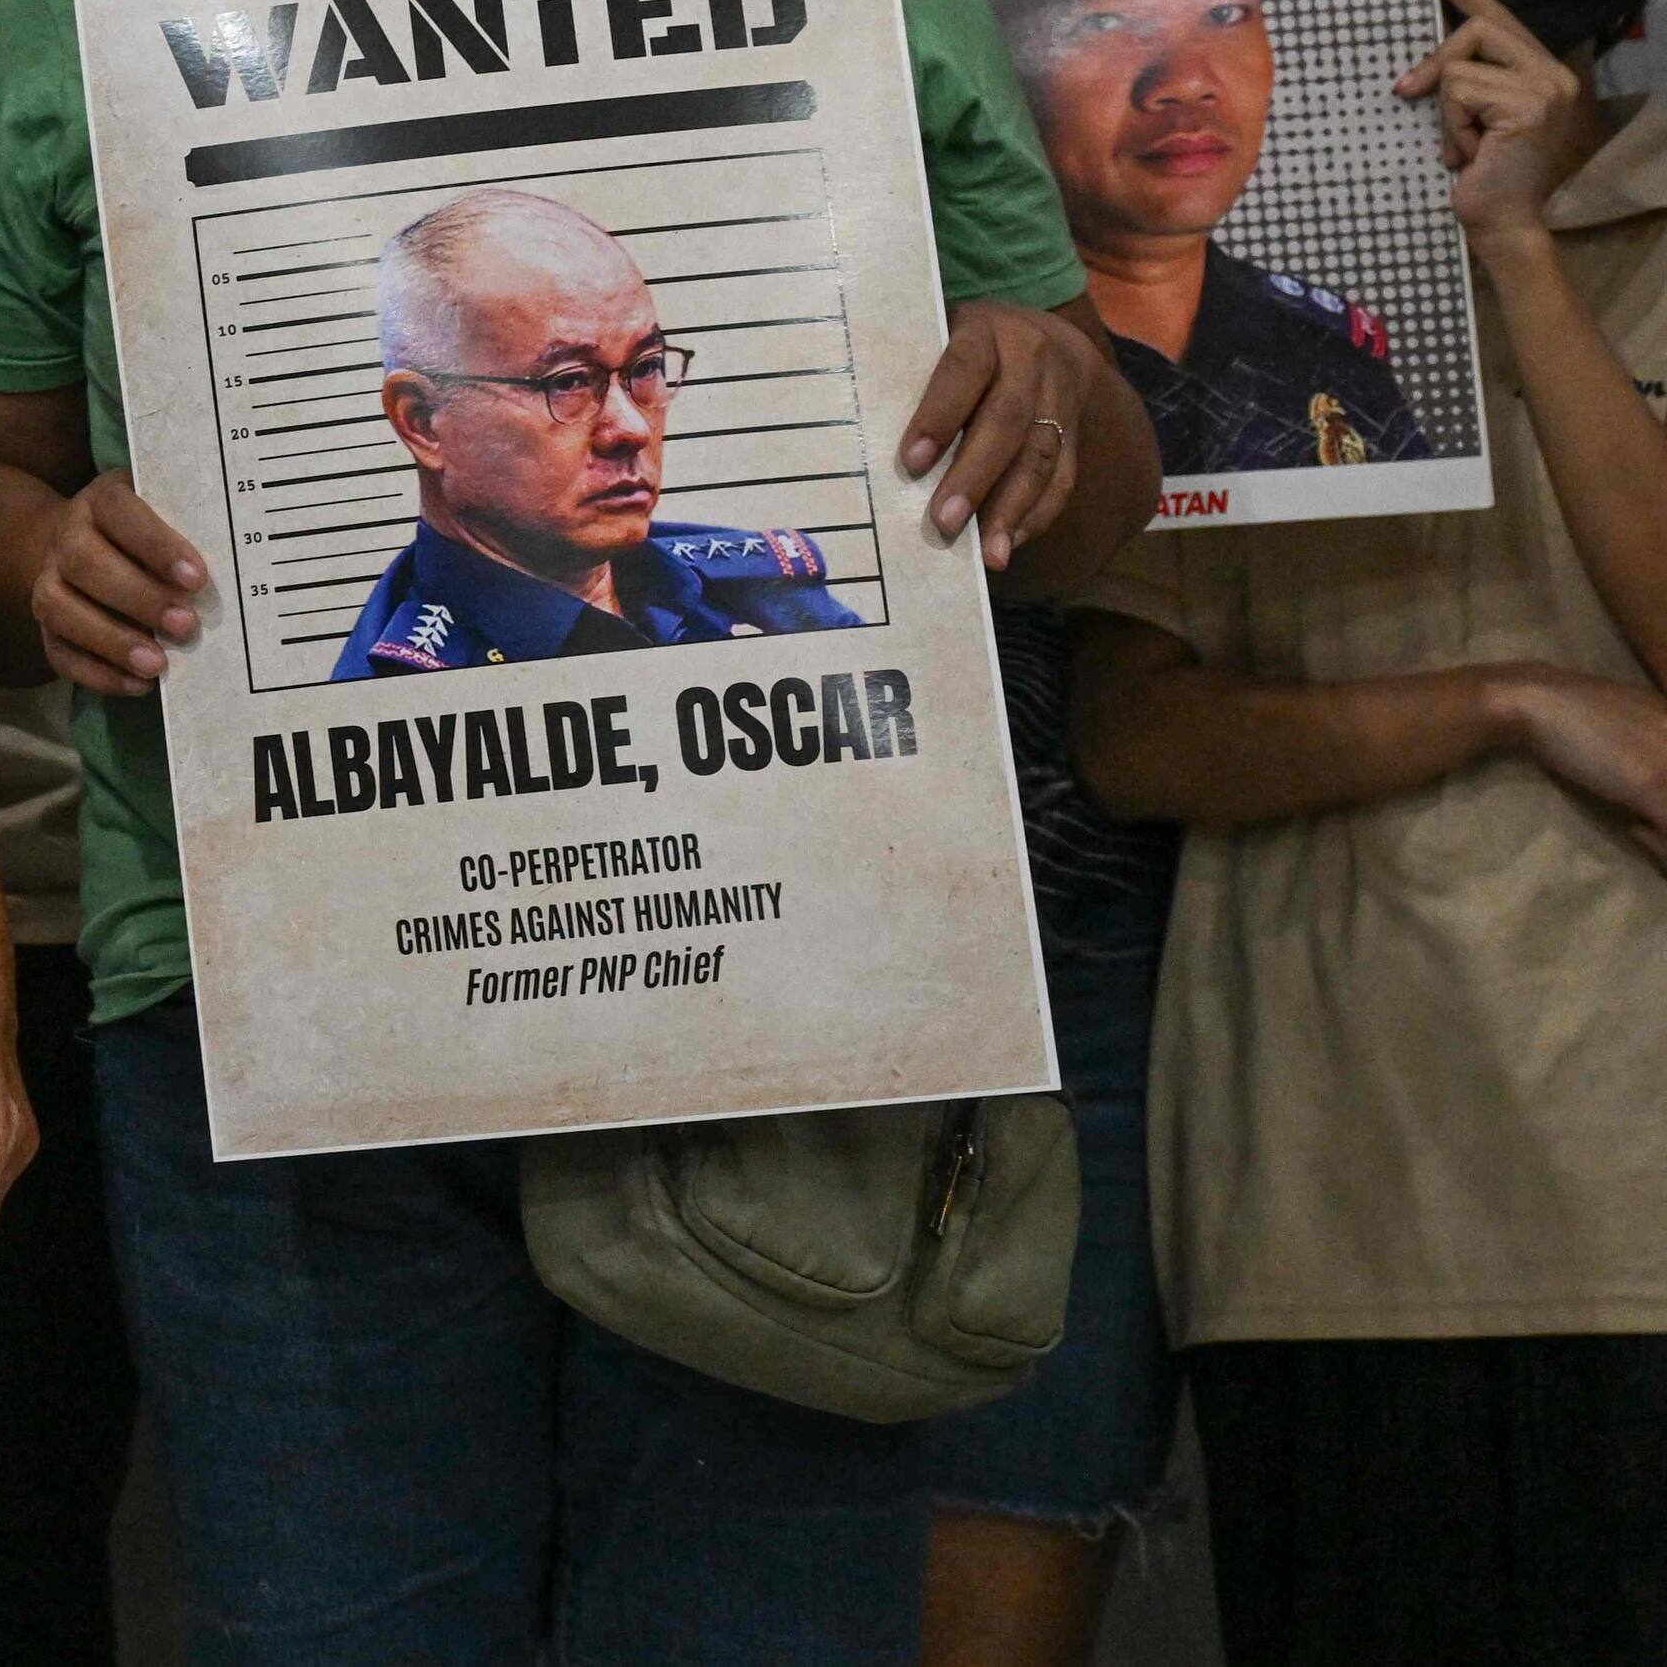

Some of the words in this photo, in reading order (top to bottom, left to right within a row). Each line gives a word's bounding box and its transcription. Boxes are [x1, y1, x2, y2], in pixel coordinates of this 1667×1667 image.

[211, 272, 231, 286] 05
[218, 324, 237, 337] 10
[224, 375, 243, 389] 15
[230, 427, 249, 441] 20
[237, 479, 256, 493] 25
[243, 531, 263, 545] 30
[250, 583, 269, 597] 35
[254, 695, 658, 823] ALBAYALDE,
[675, 668, 917, 777] OSCAR
[460, 834, 701, 892] CO-PERPETRATOR
[396, 911, 501, 955] CRIMES
[511, 898, 624, 944] AGAINST
[634, 882, 781, 932] HUMANITY
[467, 965, 574, 1005] Former
[580, 954, 636, 994] PNP
[644, 945, 724, 988] Chief
